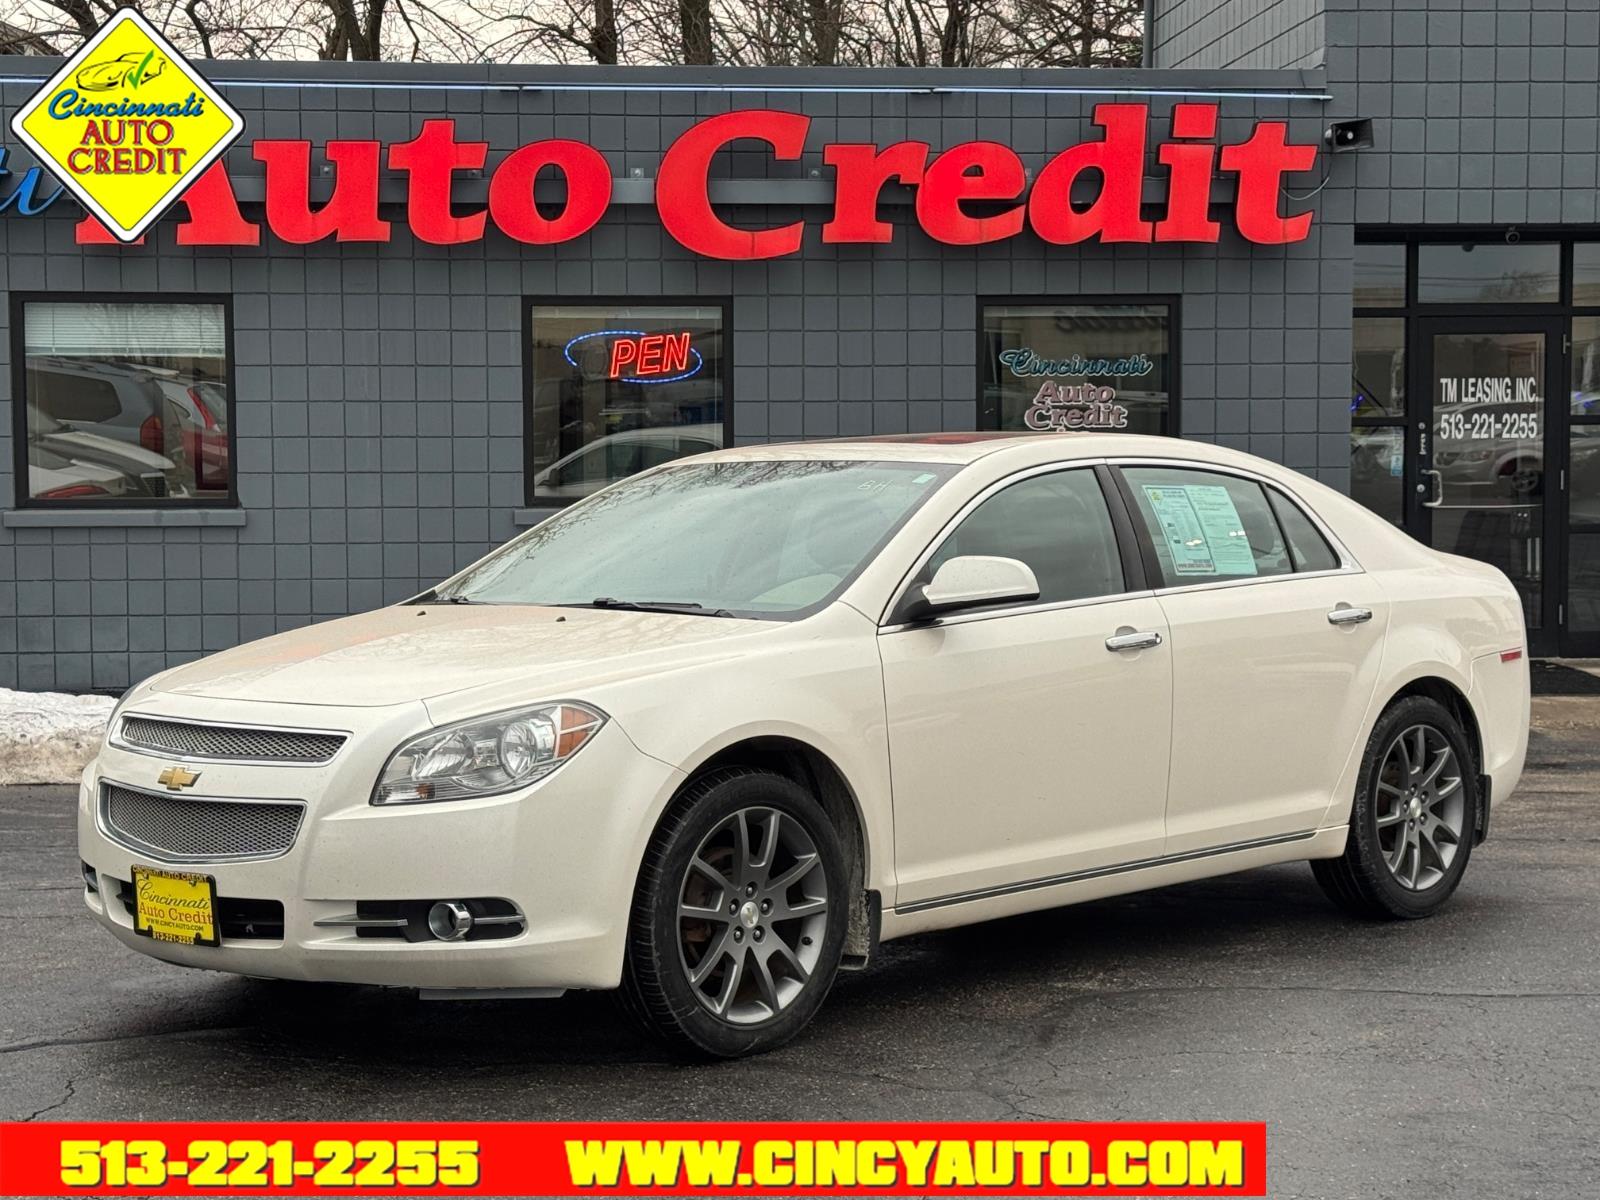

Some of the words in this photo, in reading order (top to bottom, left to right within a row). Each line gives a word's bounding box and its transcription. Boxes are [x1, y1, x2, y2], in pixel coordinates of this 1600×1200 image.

[655, 103, 1318, 261] Credit
[999, 348, 1153, 377] Cincinnati
[1033, 380, 1116, 405] Auto
[1440, 378, 1457, 402] TM
[1462, 377, 1511, 402] LEASING
[1516, 377, 1539, 402] INC.
[1024, 402, 1128, 430] Credit
[1440, 413, 1538, 439] 513-221-2255
[137, 879, 210, 909] Cincinnati
[139, 902, 164, 918] Auto
[168, 907, 213, 924] Credit
